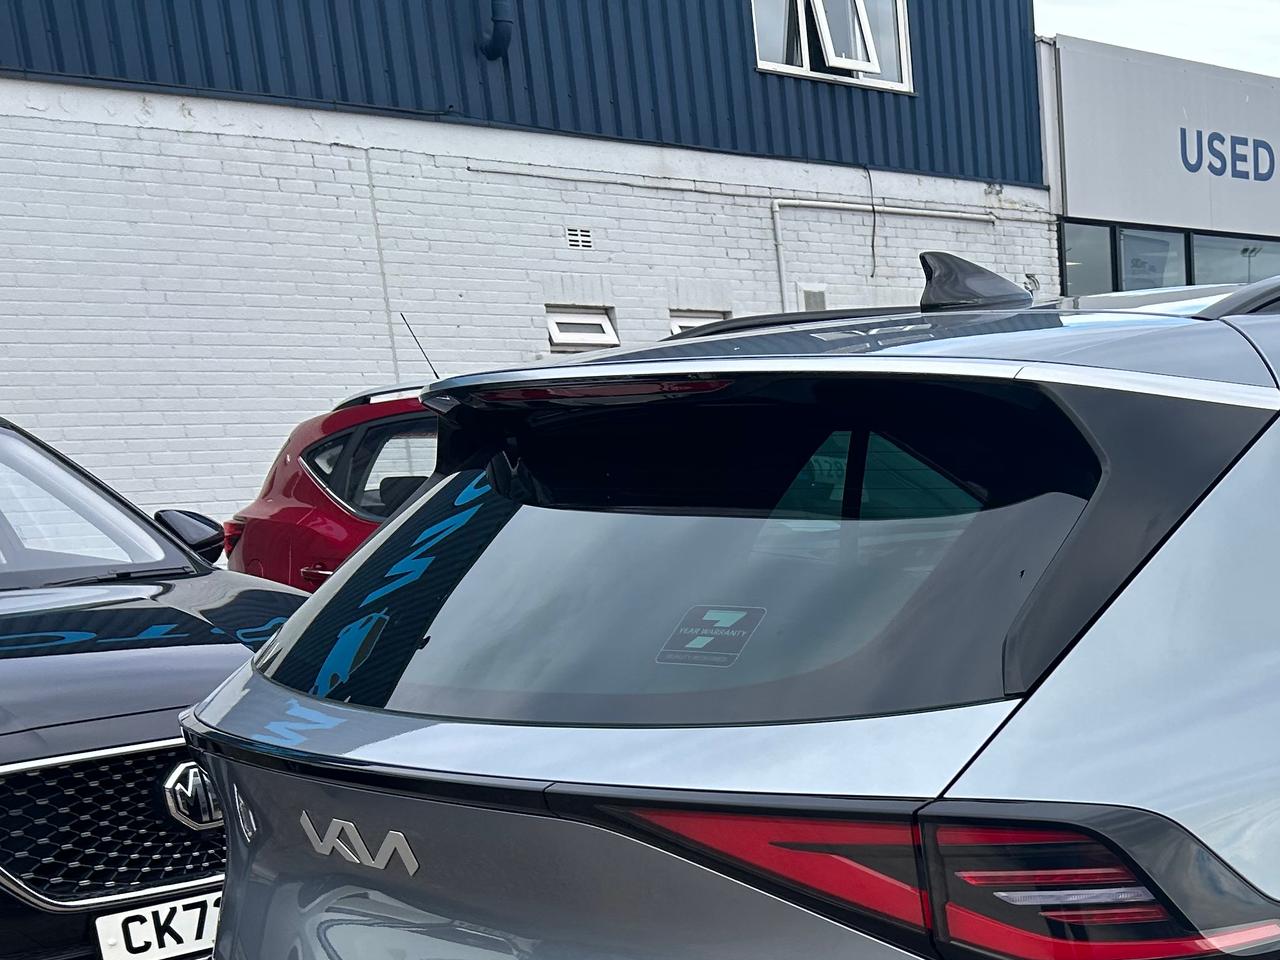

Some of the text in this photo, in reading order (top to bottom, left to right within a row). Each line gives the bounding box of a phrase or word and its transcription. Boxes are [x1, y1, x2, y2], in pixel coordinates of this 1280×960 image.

[1179, 127, 1276, 182] USED
[679, 627, 747, 638] YEAR WARRANTY
[300, 809, 420, 878] KIA
[121, 896, 222, 955] CK7
